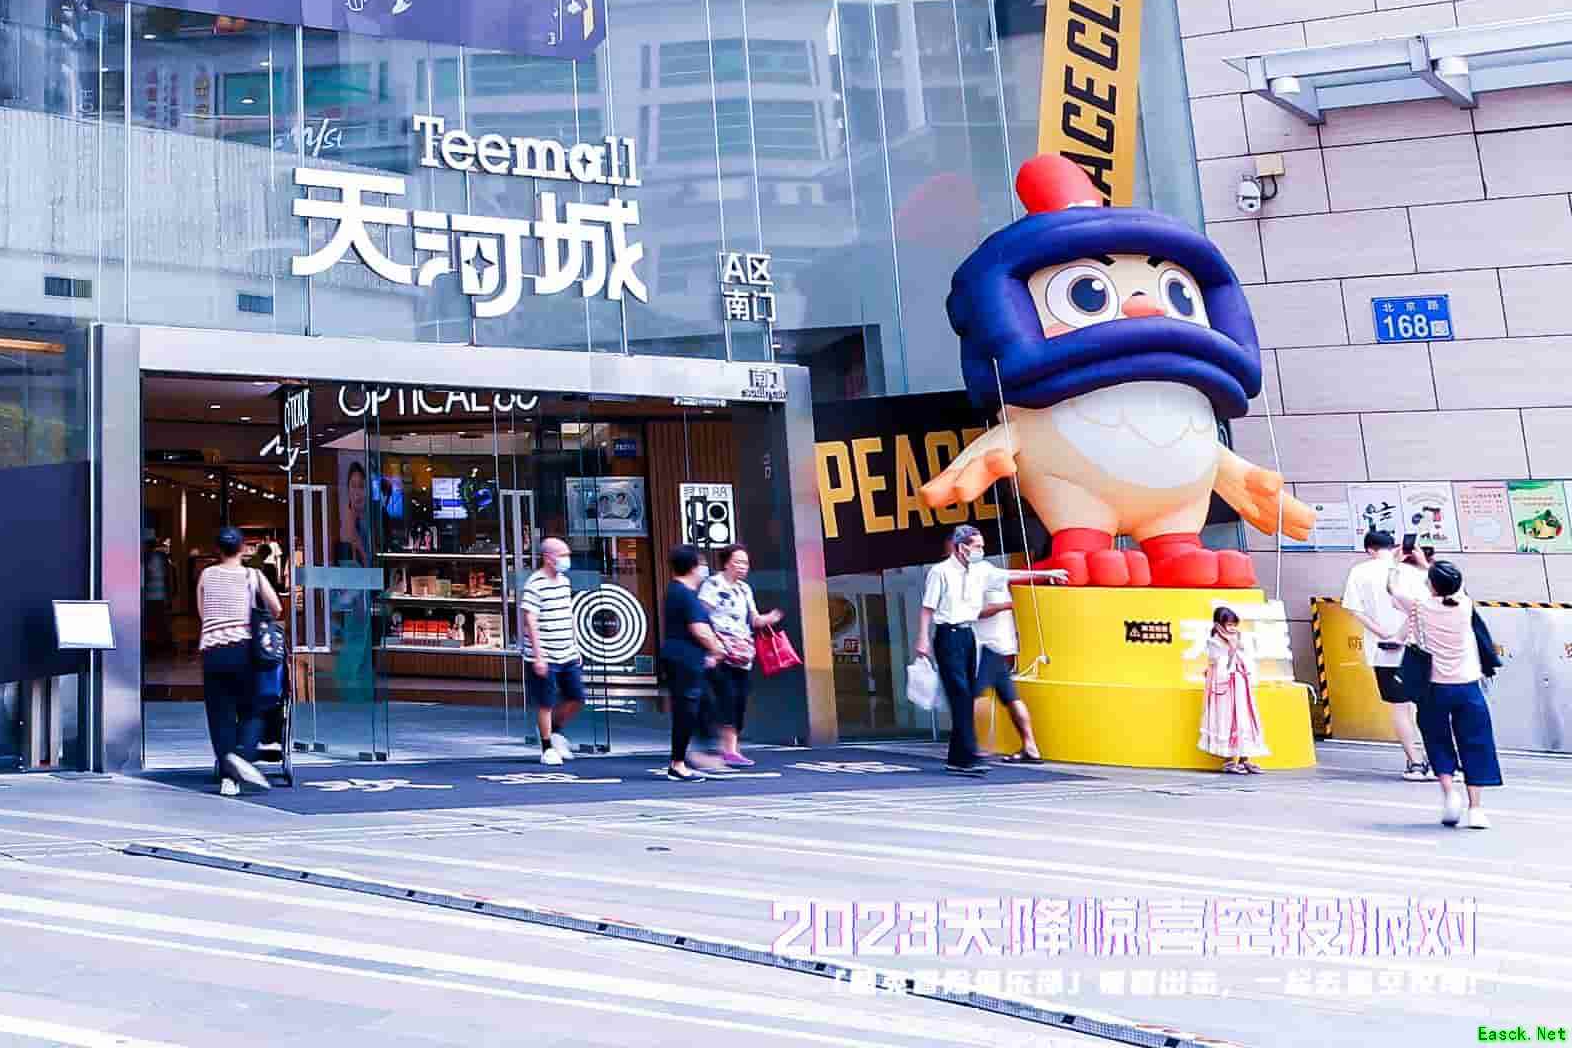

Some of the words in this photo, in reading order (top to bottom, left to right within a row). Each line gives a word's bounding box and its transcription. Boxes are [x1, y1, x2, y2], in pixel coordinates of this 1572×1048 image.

[413, 113, 642, 188] Teemall
[291, 166, 649, 319] 天河城
[723, 253, 774, 286] A区
[1383, 314, 1429, 338] 168
